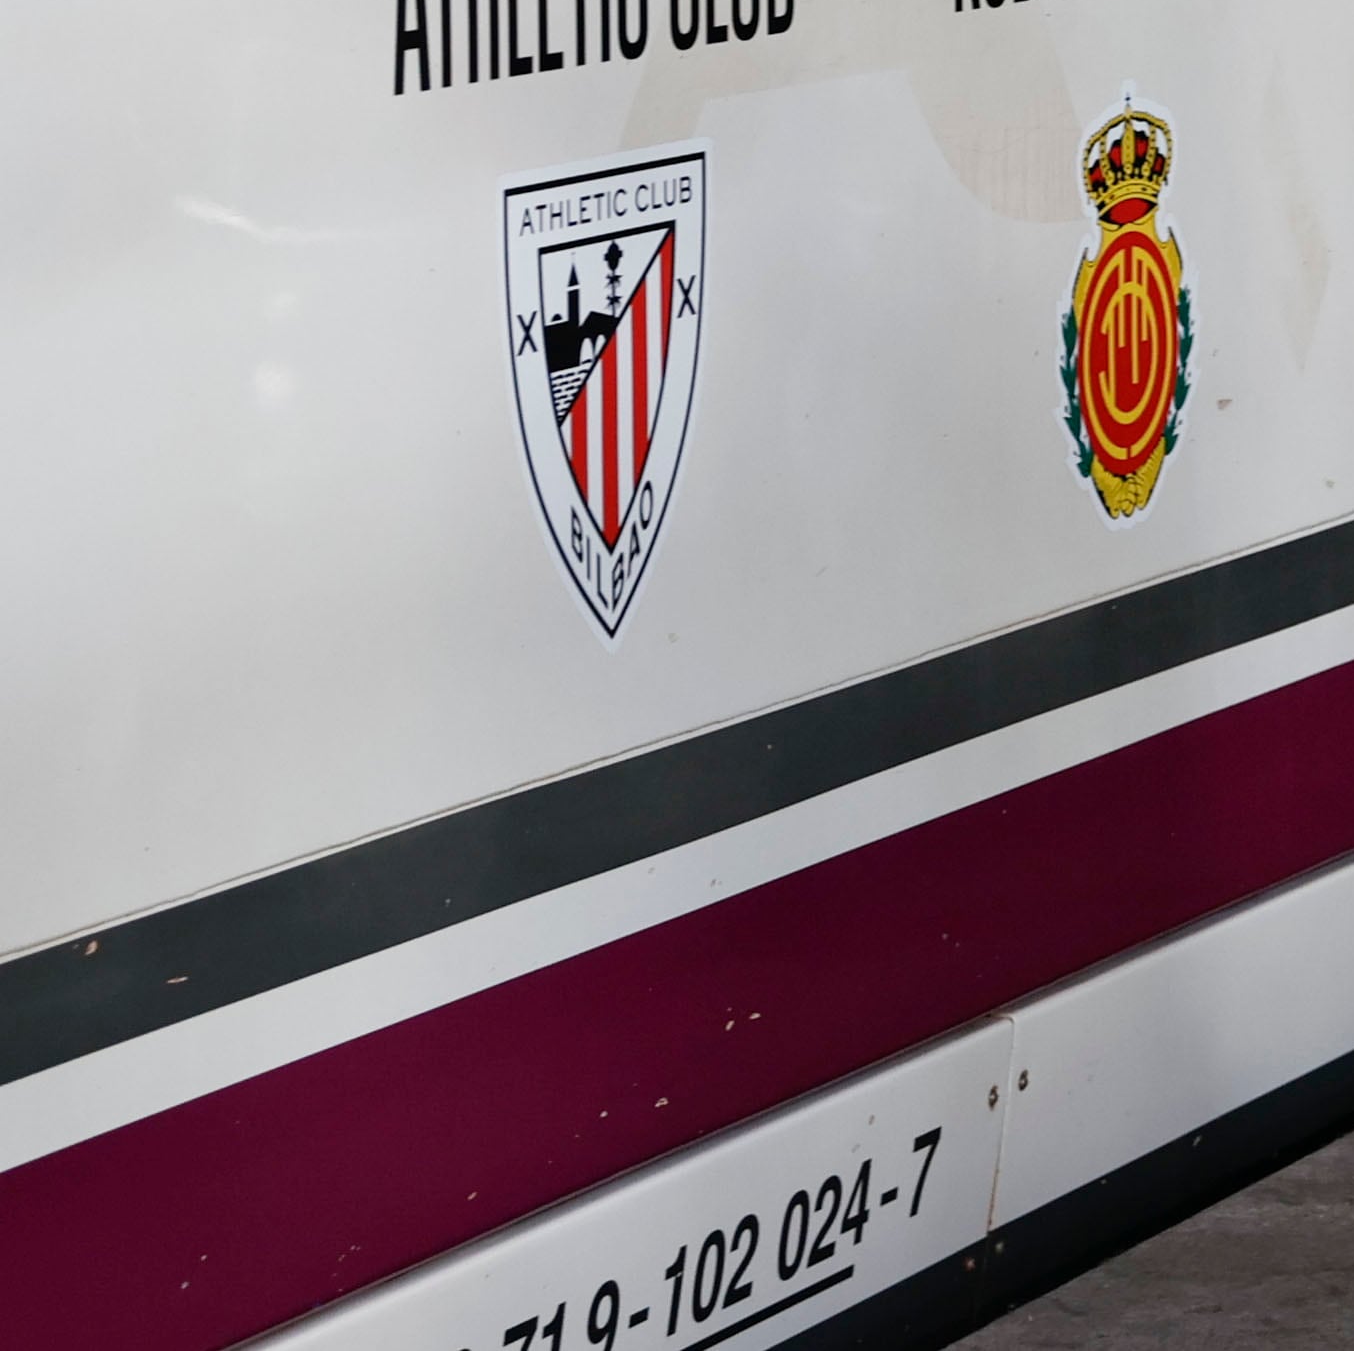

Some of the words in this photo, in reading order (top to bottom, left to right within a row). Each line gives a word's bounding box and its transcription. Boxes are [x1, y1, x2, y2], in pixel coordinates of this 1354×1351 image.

[519, 188, 627, 236] ATHLETIC
[634, 176, 693, 213] CLUB
[571, 480, 654, 612] BILBAO
[777, 1127, 942, 1280] 024-7
